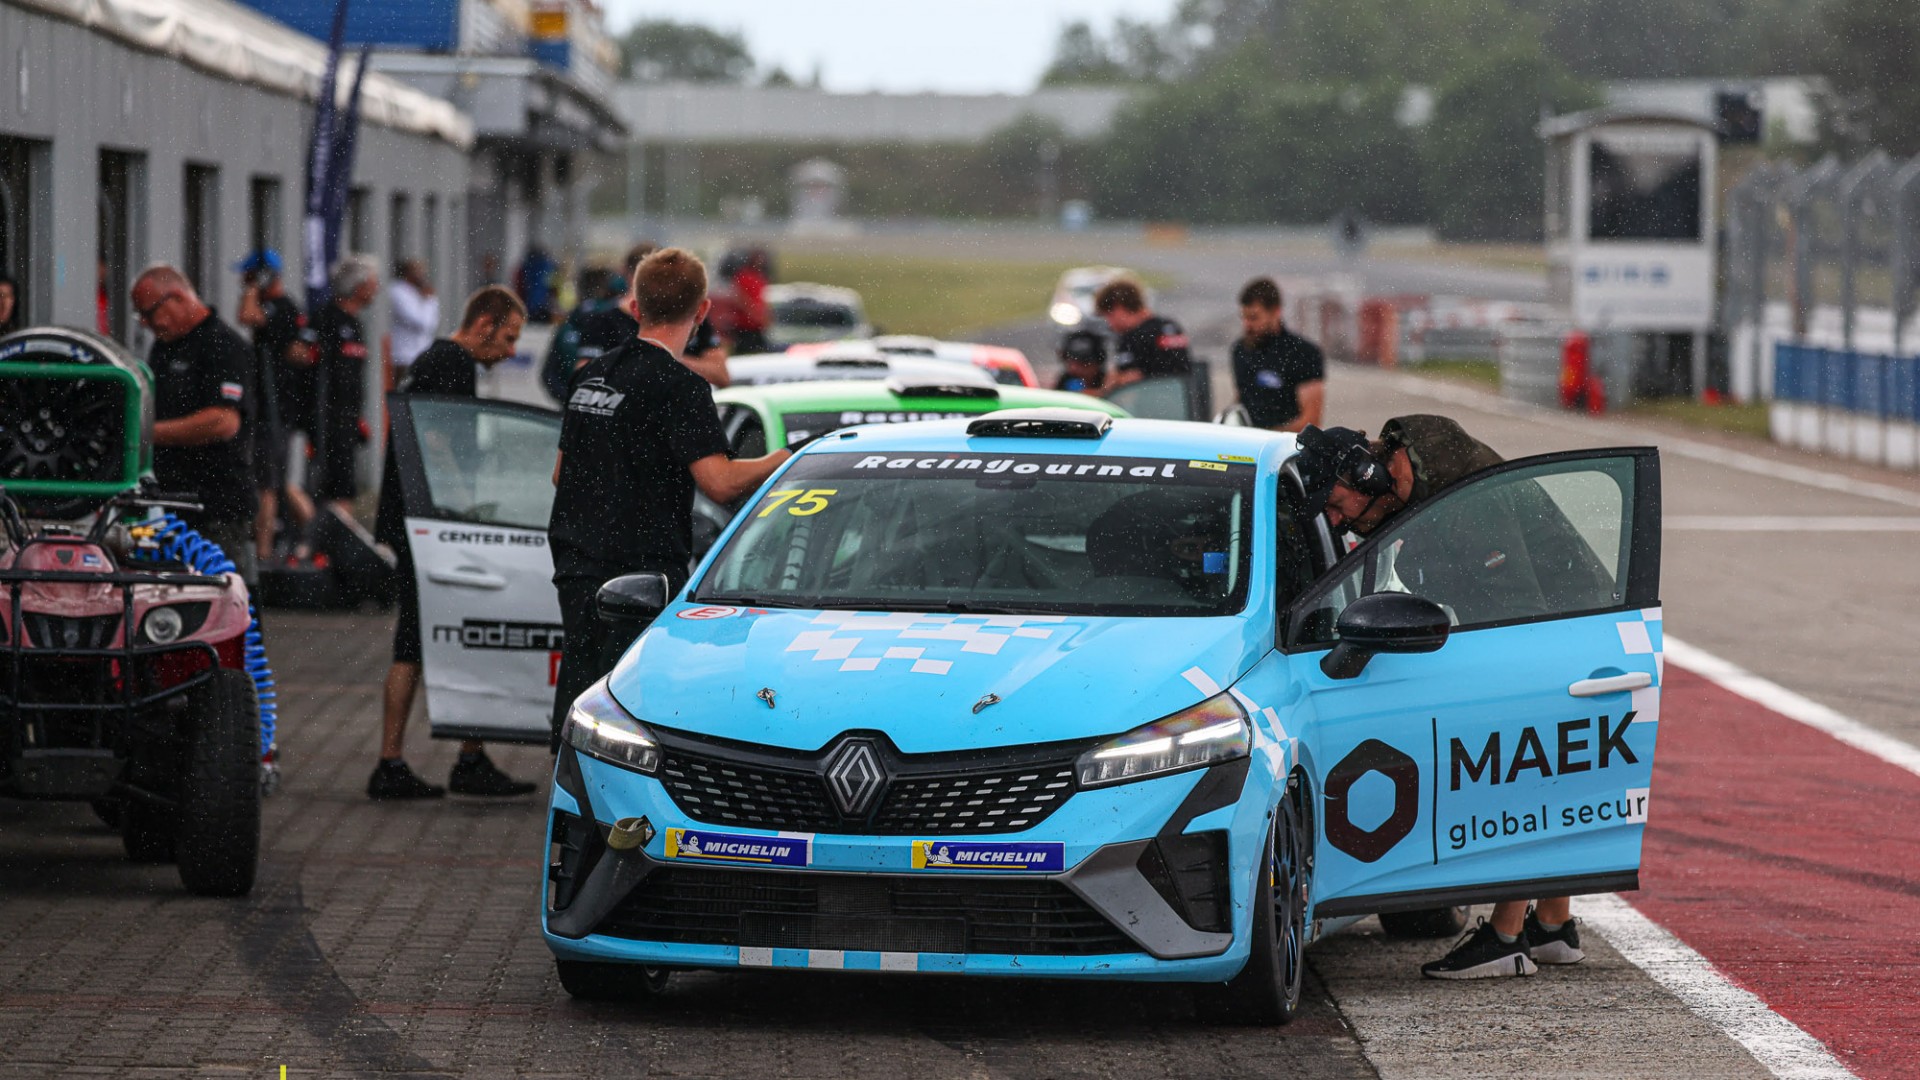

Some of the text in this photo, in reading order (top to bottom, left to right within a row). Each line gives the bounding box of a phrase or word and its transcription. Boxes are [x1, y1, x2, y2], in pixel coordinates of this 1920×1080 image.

[757, 489, 838, 518] 75
[438, 530, 546, 547] CENTER MED
[1450, 711, 1639, 792] MAEK
[1449, 796, 1646, 850] global secur
[704, 841, 791, 857] MICHELIN
[955, 851, 1047, 863] MICHELIN
